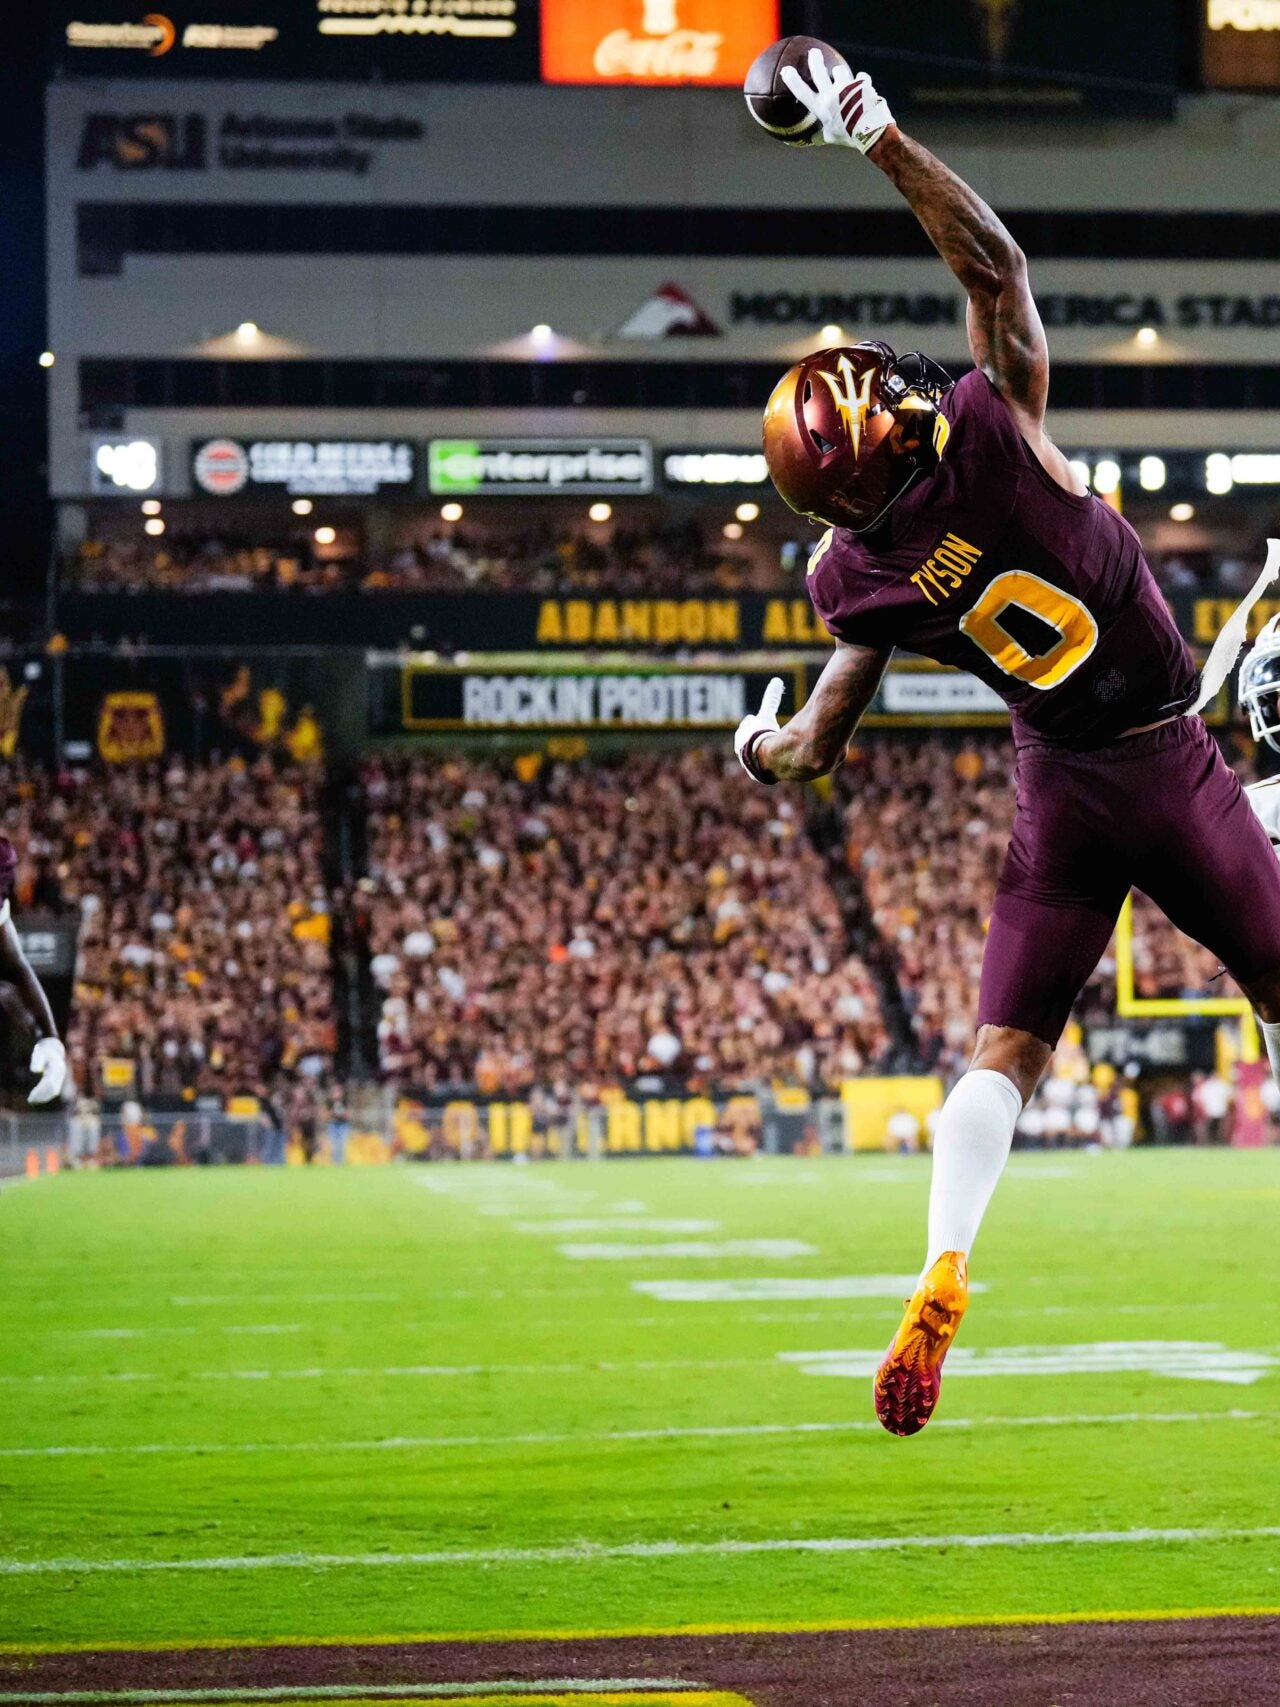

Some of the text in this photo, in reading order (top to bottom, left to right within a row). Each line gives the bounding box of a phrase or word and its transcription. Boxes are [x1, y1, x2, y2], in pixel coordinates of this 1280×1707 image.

[730, 291, 957, 326] MOUNTAIN
[1034, 293, 1165, 326] ERICA
[910, 532, 983, 606] TYSON
[536, 600, 740, 642] ABANDON
[959, 569, 1099, 690] 0
[601, 675, 745, 725] PROTEIN
